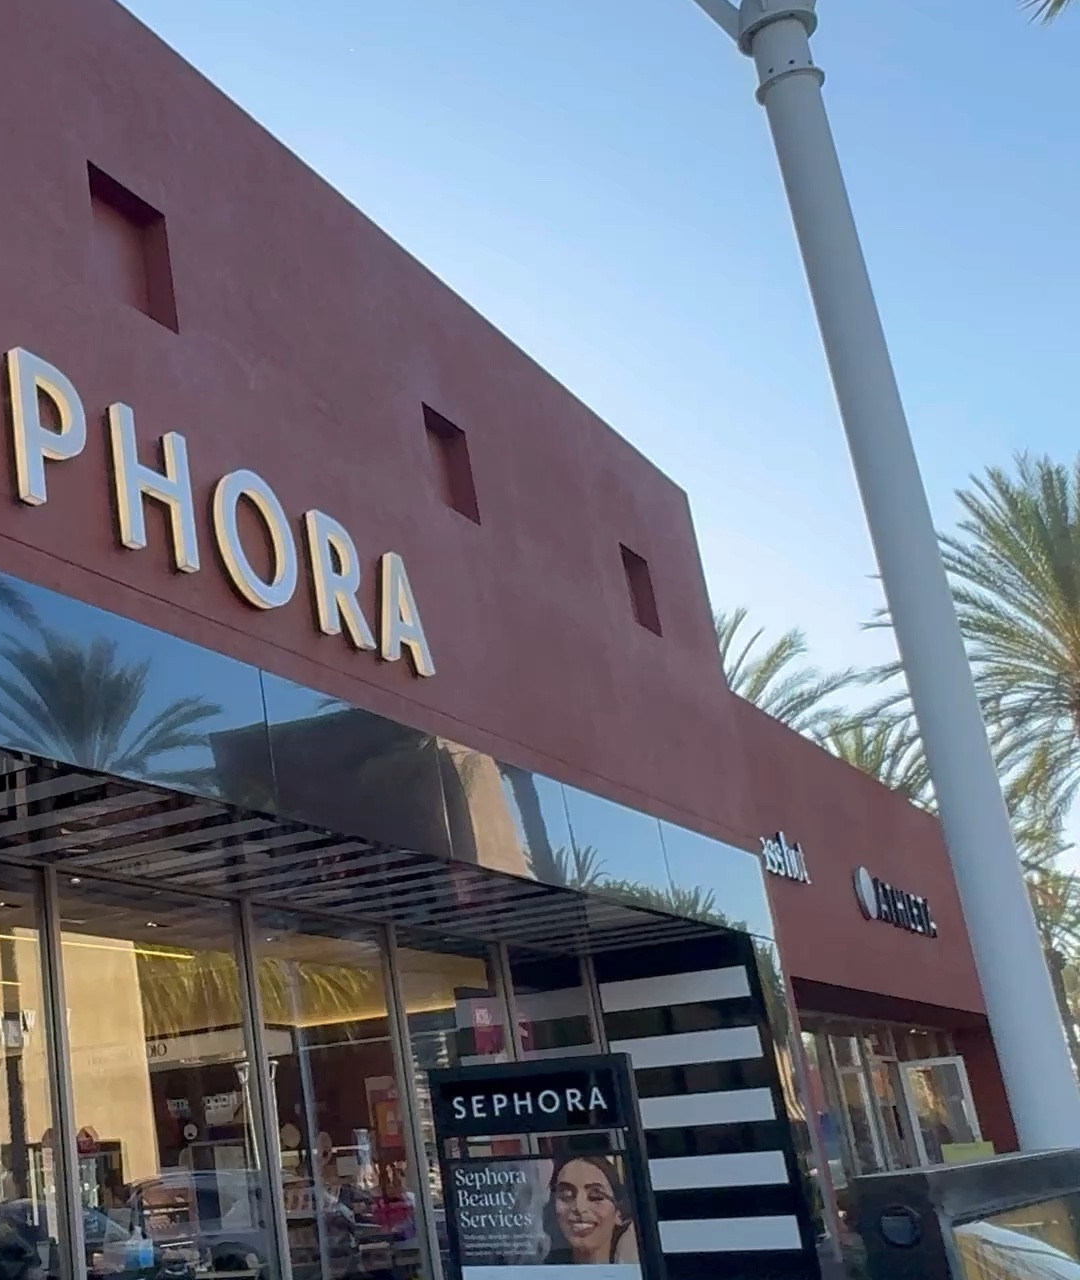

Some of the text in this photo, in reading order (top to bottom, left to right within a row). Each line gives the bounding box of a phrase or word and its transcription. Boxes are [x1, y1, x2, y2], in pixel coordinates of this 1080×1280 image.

[452, 1087, 607, 1120] SEPHORA
[455, 1167, 526, 1189] Sephora
[457, 1189, 518, 1209] Beauty
[460, 1210, 532, 1228] Services
